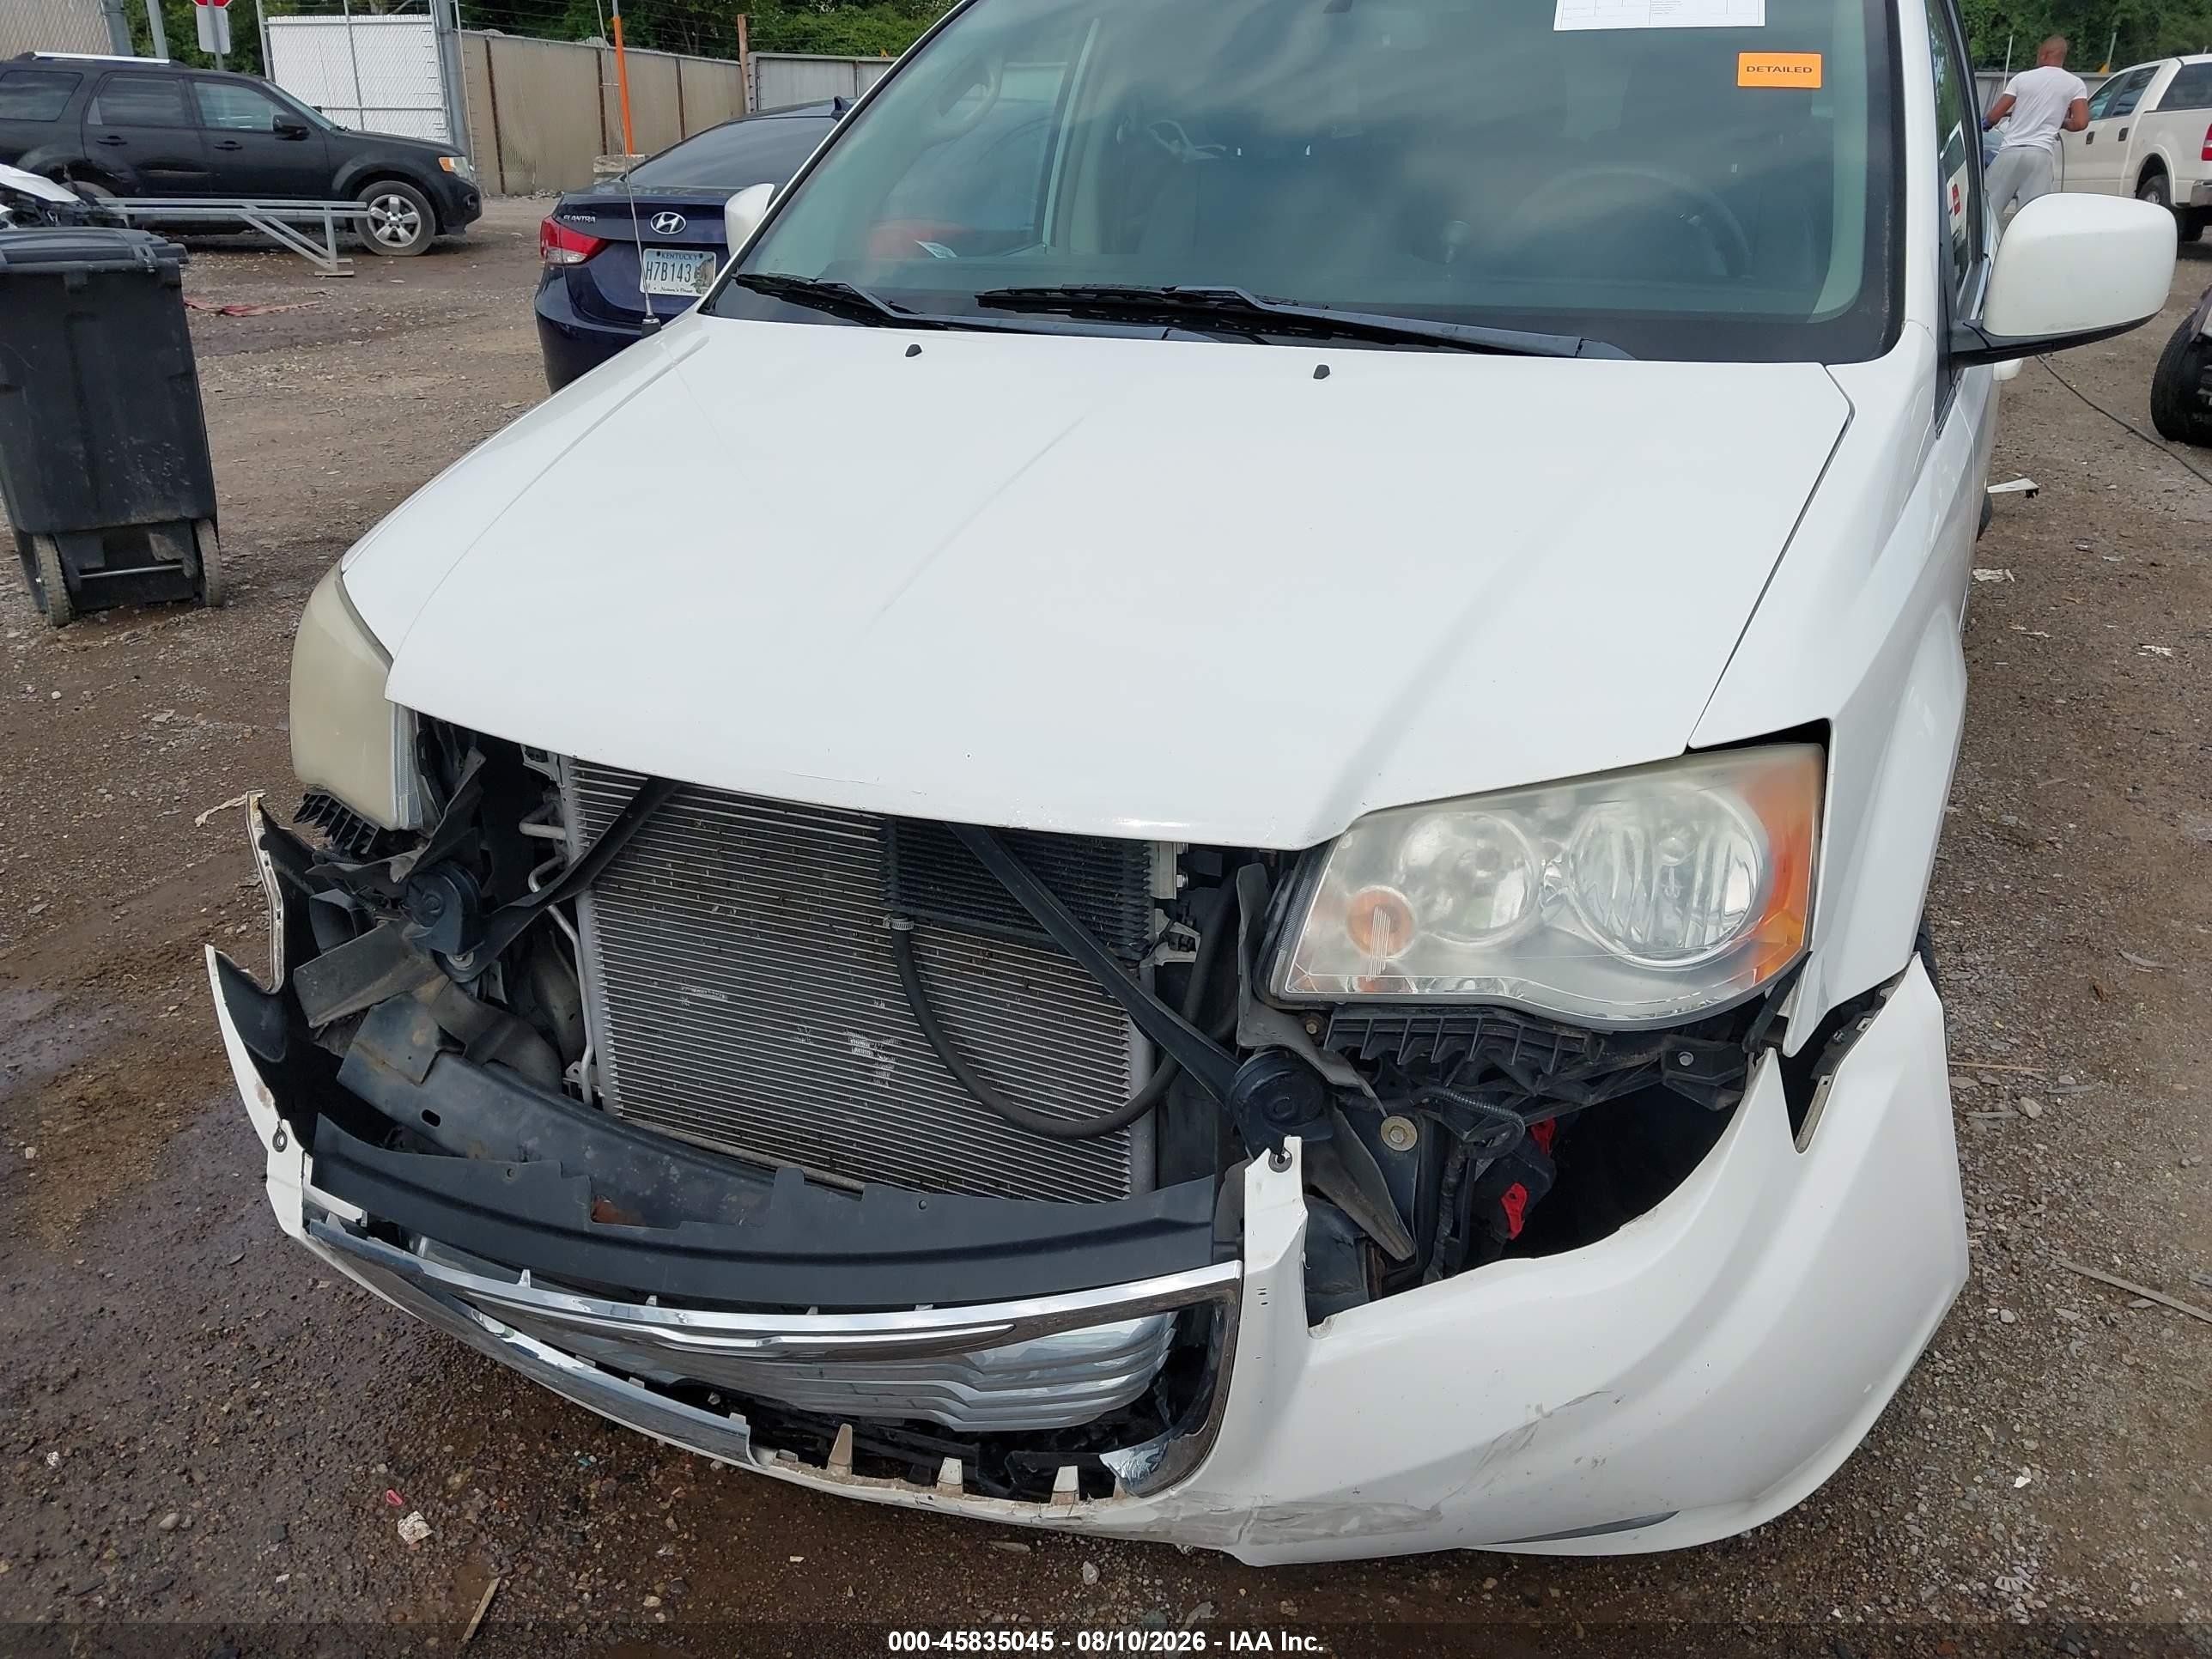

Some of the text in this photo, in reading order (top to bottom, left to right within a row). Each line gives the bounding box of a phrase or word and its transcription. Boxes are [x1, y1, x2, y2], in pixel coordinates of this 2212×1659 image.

[1746, 65, 1813, 74] DETAILED
[661, 252, 697, 261] KENTUCKY
[646, 260, 692, 283] H7B143
